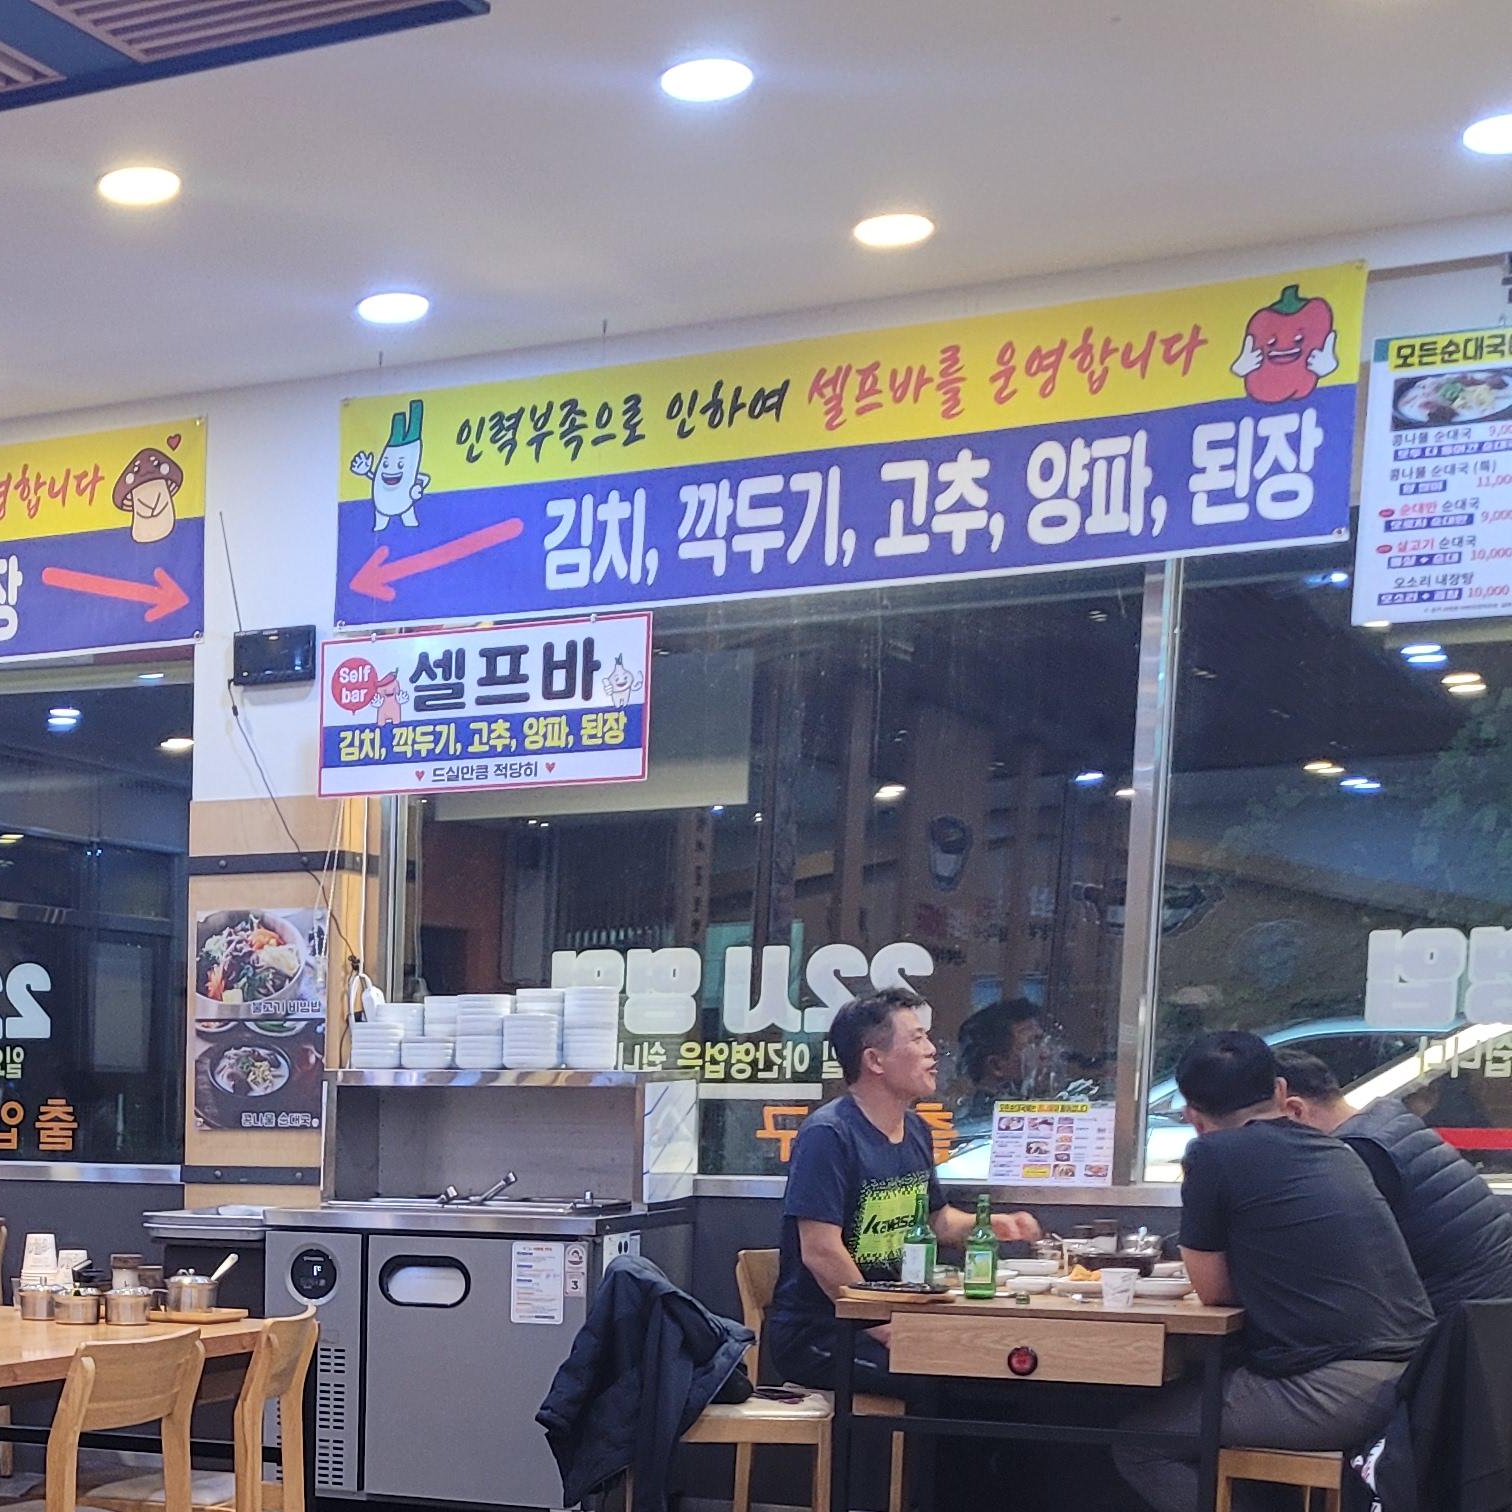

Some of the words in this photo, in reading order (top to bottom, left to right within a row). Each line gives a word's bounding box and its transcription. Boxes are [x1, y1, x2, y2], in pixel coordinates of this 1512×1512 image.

[1394, 334, 1512, 369] 모든순대국
[456, 393, 645, 465] 인력부족으로
[666, 378, 790, 439] 인하여
[807, 344, 966, 431] 셀프바를
[990, 323, 1208, 405] 운영합니다
[1434, 427, 1472, 443] 순대국
[1432, 462, 1469, 478] 순대국
[544, 488, 658, 591] 김치,
[678, 465, 855, 577] 깍두기,
[874, 447, 1004, 558] 고추,
[1027, 429, 1167, 545] 양파,
[1189, 408, 1324, 526] 된장
[1442, 498, 1480, 512] 순대국
[1439, 536, 1477, 550] 순대국
[1393, 575, 1431, 590] 오소리
[339, 664, 371, 683] Self
[409, 637, 601, 713] 셀프바
[341, 685, 368, 704] bar
[339, 728, 386, 763] 김치,
[392, 722, 462, 759] 깍두기,
[468, 718, 517, 753] 고추,
[523, 714, 573, 748] 양파,
[581, 711, 627, 746] 된장
[432, 764, 489, 783] 드실만큼
[493, 761, 538, 780] 적당히
[252, 1001, 286, 1015] 불고기
[288, 1000, 321, 1014] 비빔밥
[242, 1112, 276, 1127] 콩나물
[278, 1112, 311, 1127] 순대국
